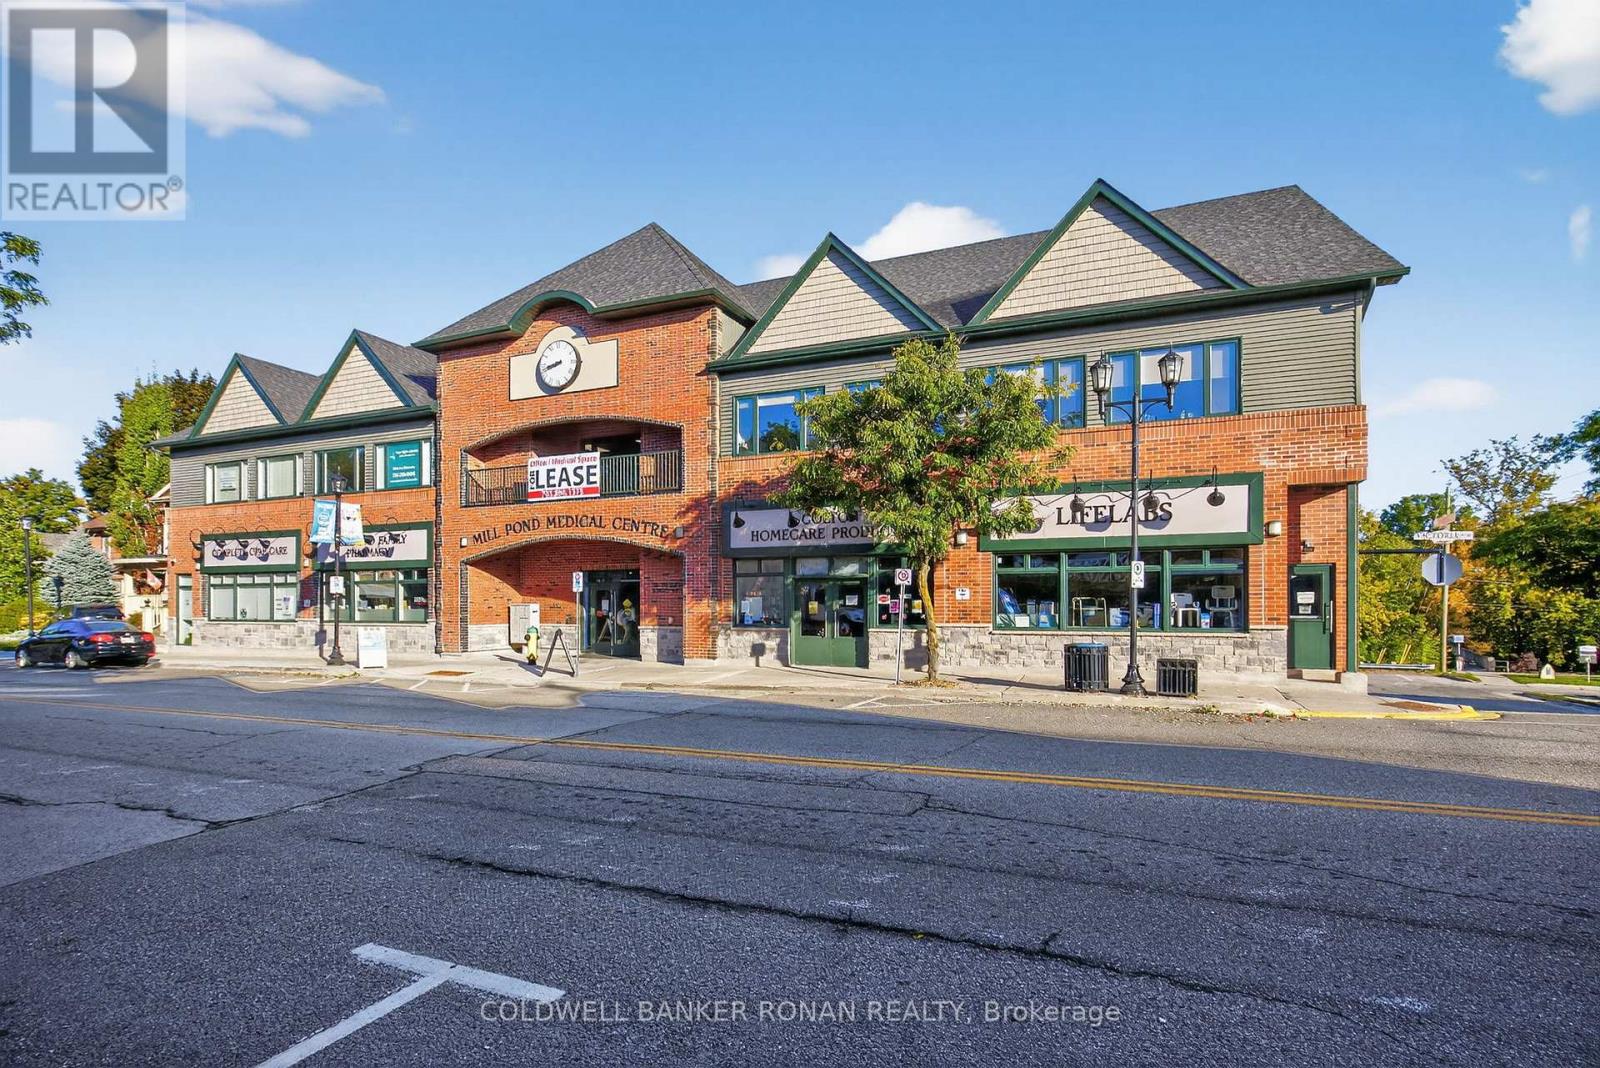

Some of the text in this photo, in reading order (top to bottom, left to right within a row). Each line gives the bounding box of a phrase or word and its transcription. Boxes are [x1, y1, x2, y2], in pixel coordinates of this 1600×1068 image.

[577, 455, 598, 465] Space
[536, 465, 598, 489] LEASE
[1055, 502, 1173, 526] LIFELABS
[378, 533, 407, 546] FALY
[473, 515, 669, 546] MILL POND MEDICAL CENTRE
[751, 527, 826, 543] HOMECARE
